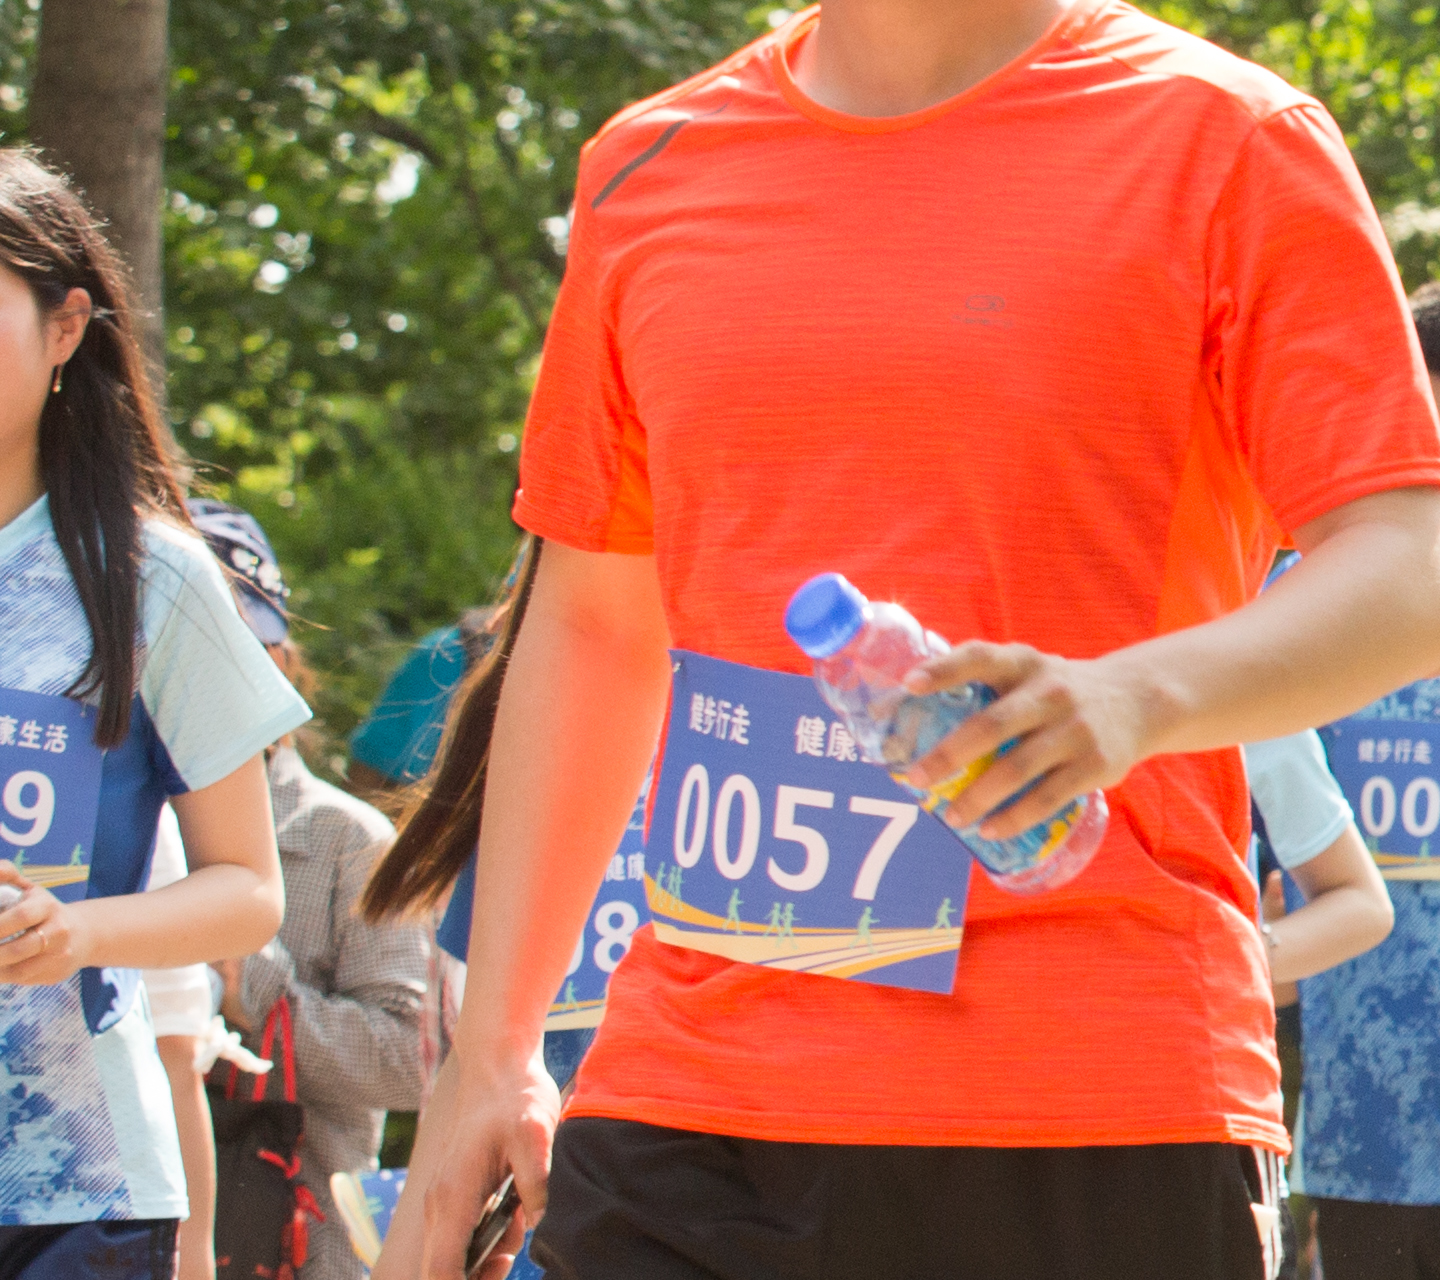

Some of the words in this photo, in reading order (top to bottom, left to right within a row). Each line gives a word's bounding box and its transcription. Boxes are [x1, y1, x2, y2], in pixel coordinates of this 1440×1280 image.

[795, 715, 884, 764] 健康
[673, 763, 919, 901] 0057
[567, 901, 639, 976] 8
